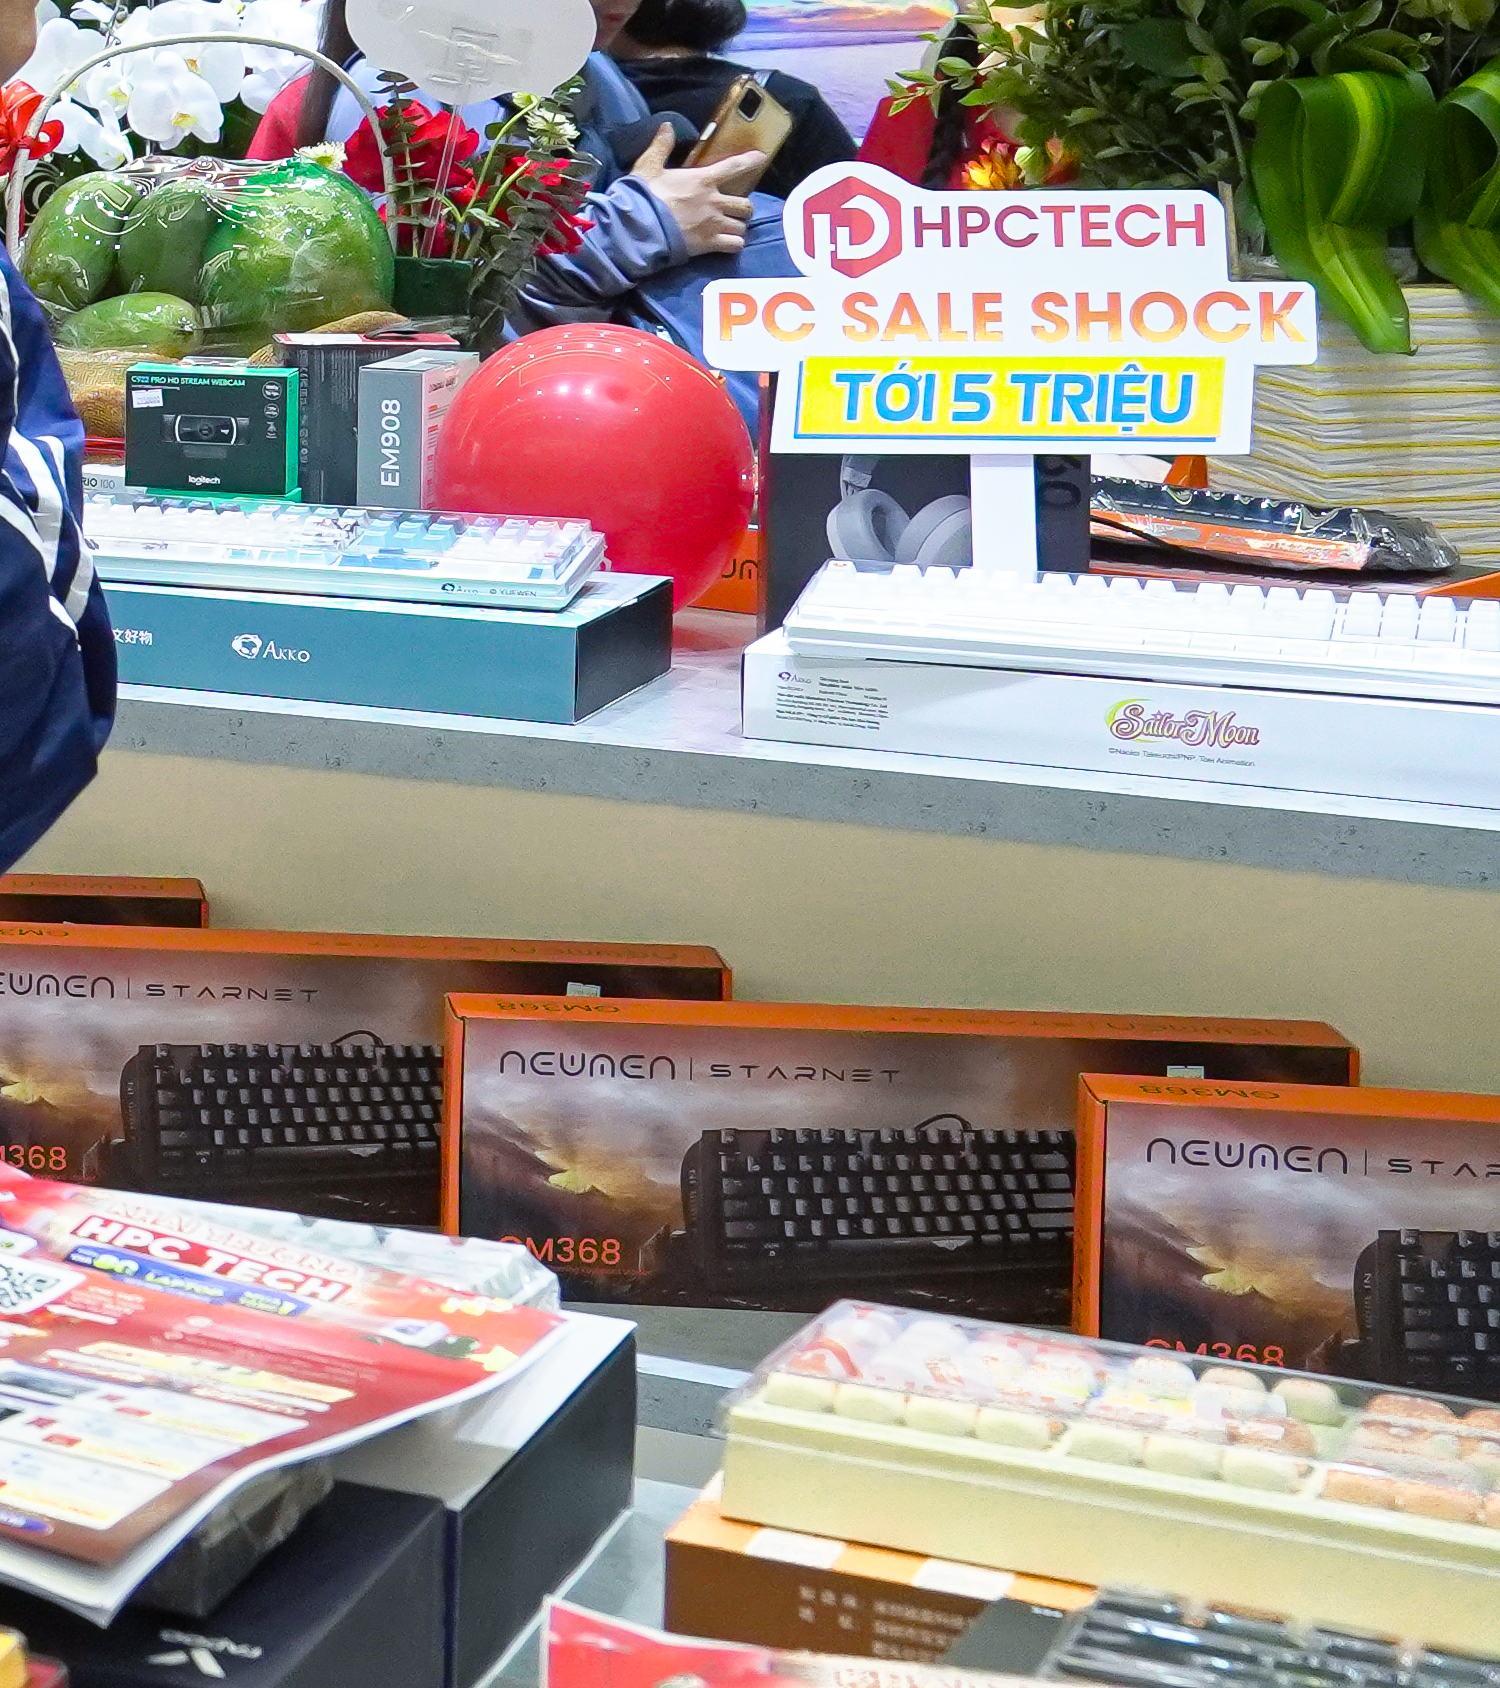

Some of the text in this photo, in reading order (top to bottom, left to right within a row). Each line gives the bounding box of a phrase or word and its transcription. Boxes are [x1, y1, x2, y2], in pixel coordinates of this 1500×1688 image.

[914, 203, 1206, 248] HPCTECH
[719, 292, 1308, 343] PC SALE SHOCK
[835, 362, 1195, 436] TỚI 5 TRIỆU
[381, 399, 401, 487] EM908
[1110, 704, 1260, 749] Sailor Moon
[145, 983, 320, 1005] STARNET
[500, 1050, 901, 1084] NEWMEN STARNET
[1146, 1137, 1348, 1175] NEWMEN
[77, 1216, 190, 1263] HPC
[203, 1249, 348, 1304] TECH
